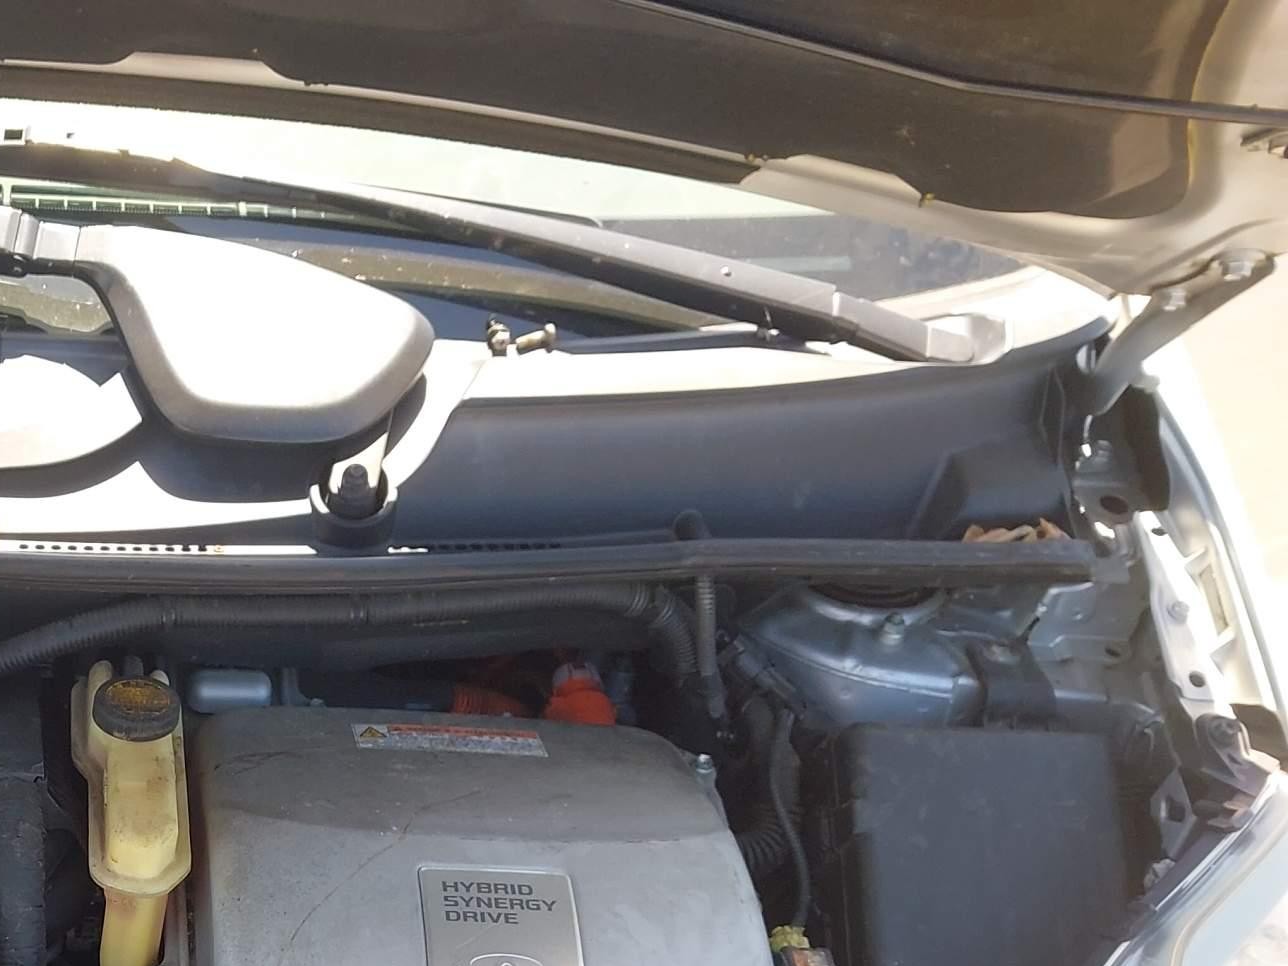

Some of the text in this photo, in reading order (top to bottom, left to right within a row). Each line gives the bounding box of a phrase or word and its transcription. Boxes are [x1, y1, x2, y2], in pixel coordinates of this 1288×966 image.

[441, 881, 533, 895] HYBRID
[443, 895, 557, 912] SYNERGY
[445, 910, 520, 924] DRIVE
